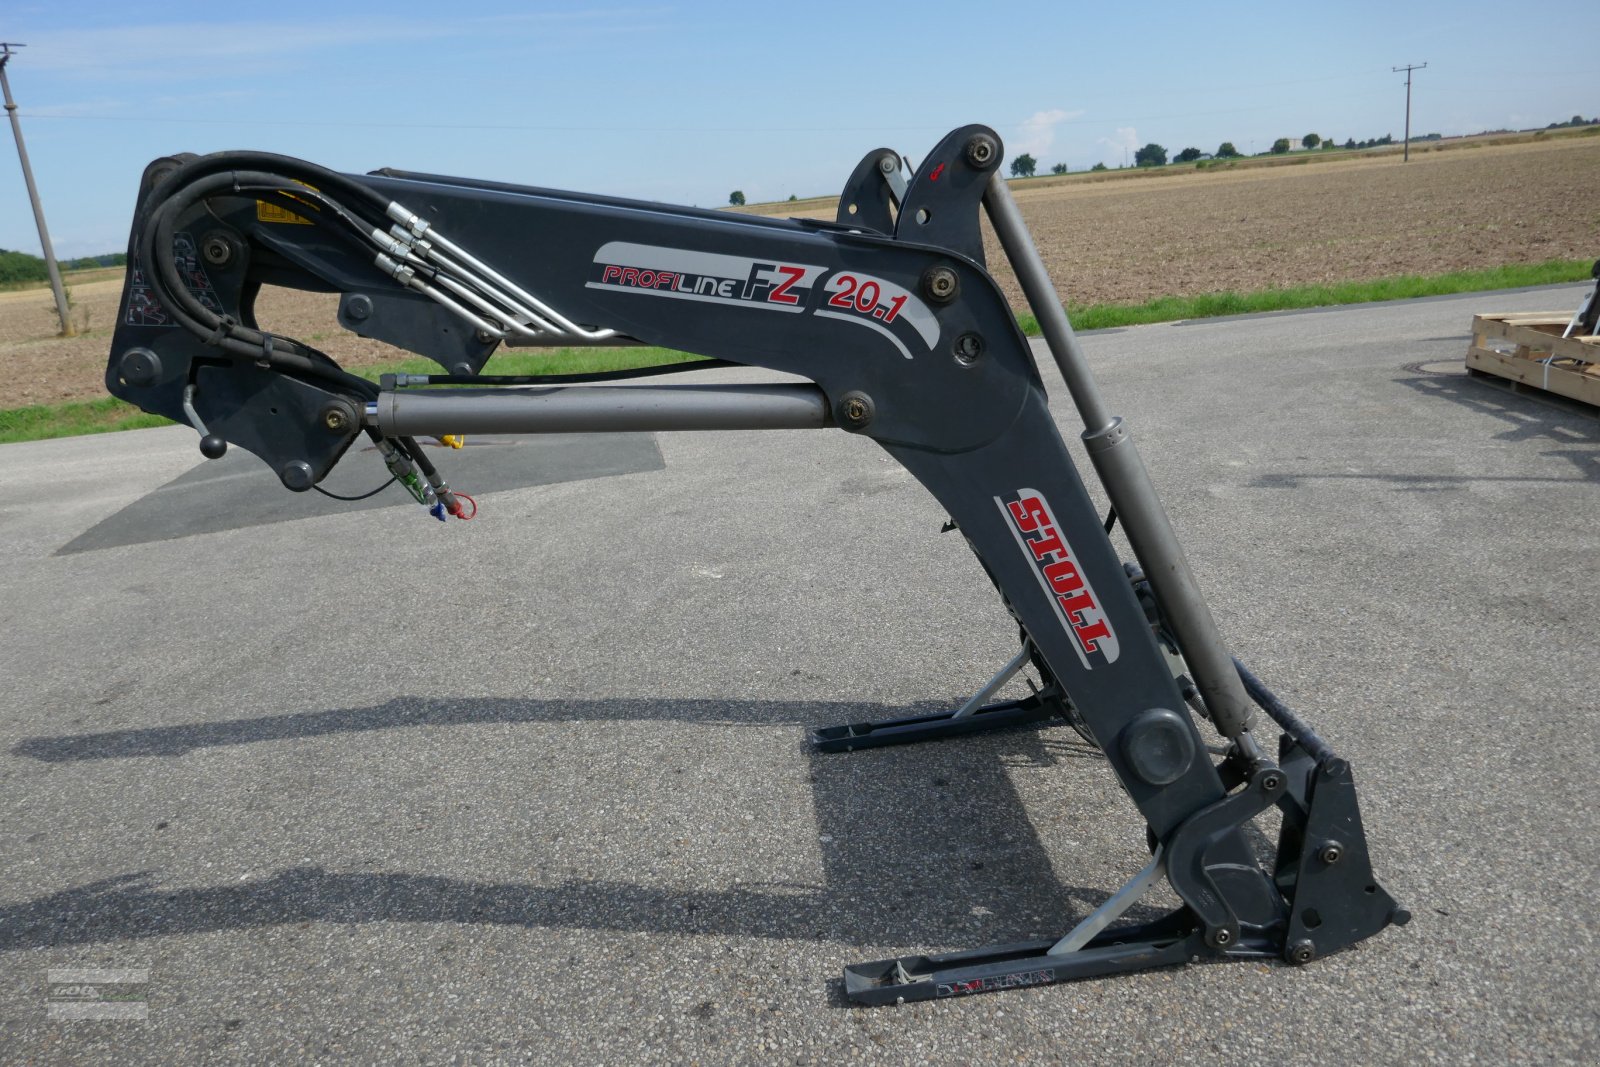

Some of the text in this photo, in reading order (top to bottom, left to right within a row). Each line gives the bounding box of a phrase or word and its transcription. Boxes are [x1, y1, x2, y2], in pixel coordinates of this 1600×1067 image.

[602, 262, 909, 324] PROFILINE FZ 20.1
[1007, 496, 1112, 653] STOLL
